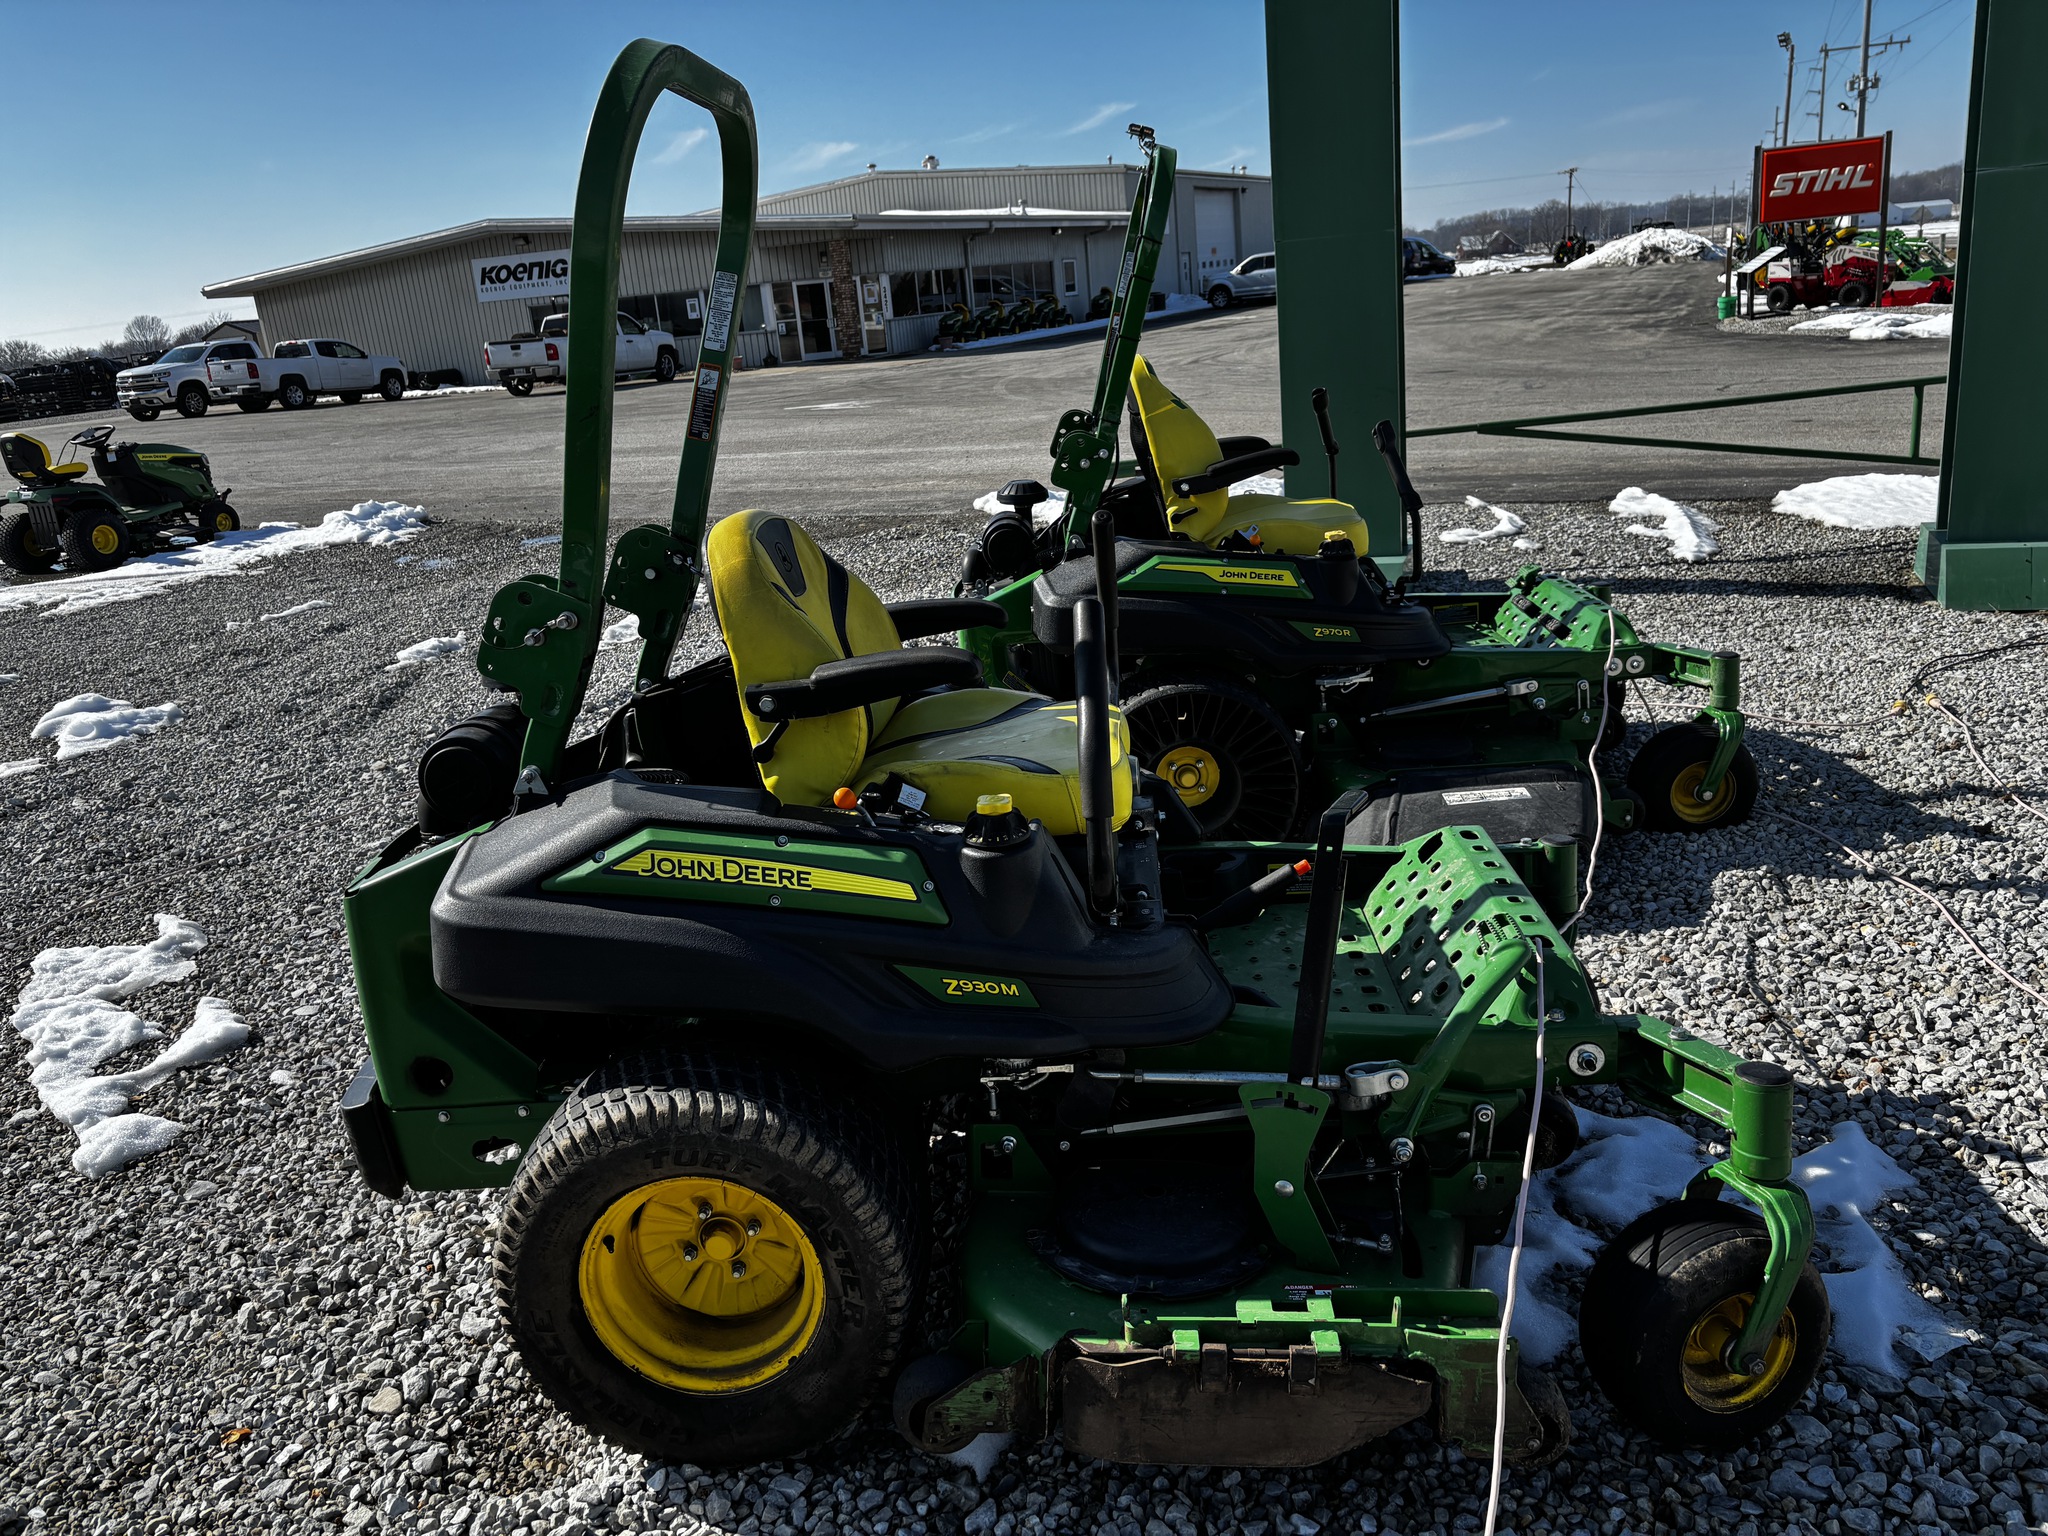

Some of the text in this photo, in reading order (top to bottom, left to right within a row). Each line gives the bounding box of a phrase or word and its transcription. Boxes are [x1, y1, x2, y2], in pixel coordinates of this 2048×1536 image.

[1769, 164, 1874, 197] STIHL
[480, 285, 506, 293] KOENIG
[1219, 569, 1285, 582] JOHN DEERE
[1313, 627, 1351, 638] Z970R
[640, 853, 813, 889] JOHN DEERE
[942, 978, 1020, 997] Z930M
[644, 1149, 762, 1173] TURF
